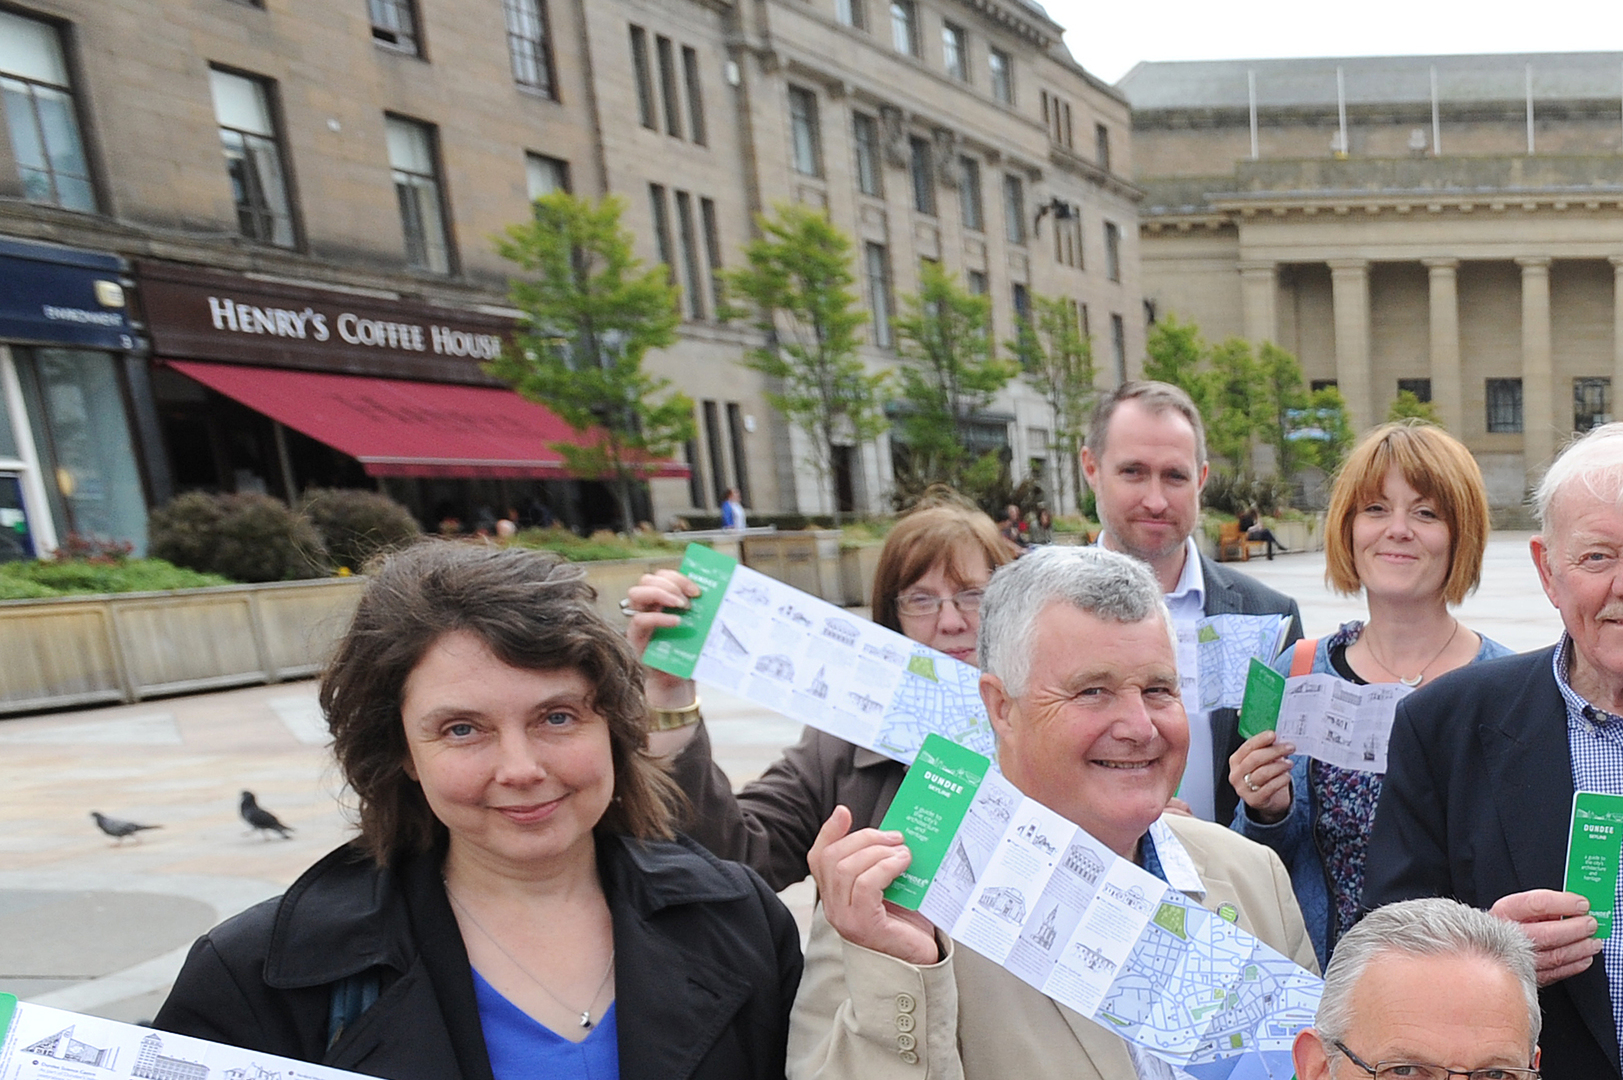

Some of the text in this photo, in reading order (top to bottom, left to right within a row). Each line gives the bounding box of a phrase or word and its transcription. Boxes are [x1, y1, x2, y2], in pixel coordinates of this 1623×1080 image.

[207, 296, 330, 342] HENRY'S
[336, 312, 426, 352] COFFEE
[924, 771, 964, 795] DUNDEE
[1583, 824, 1614, 834] DUNDEE
